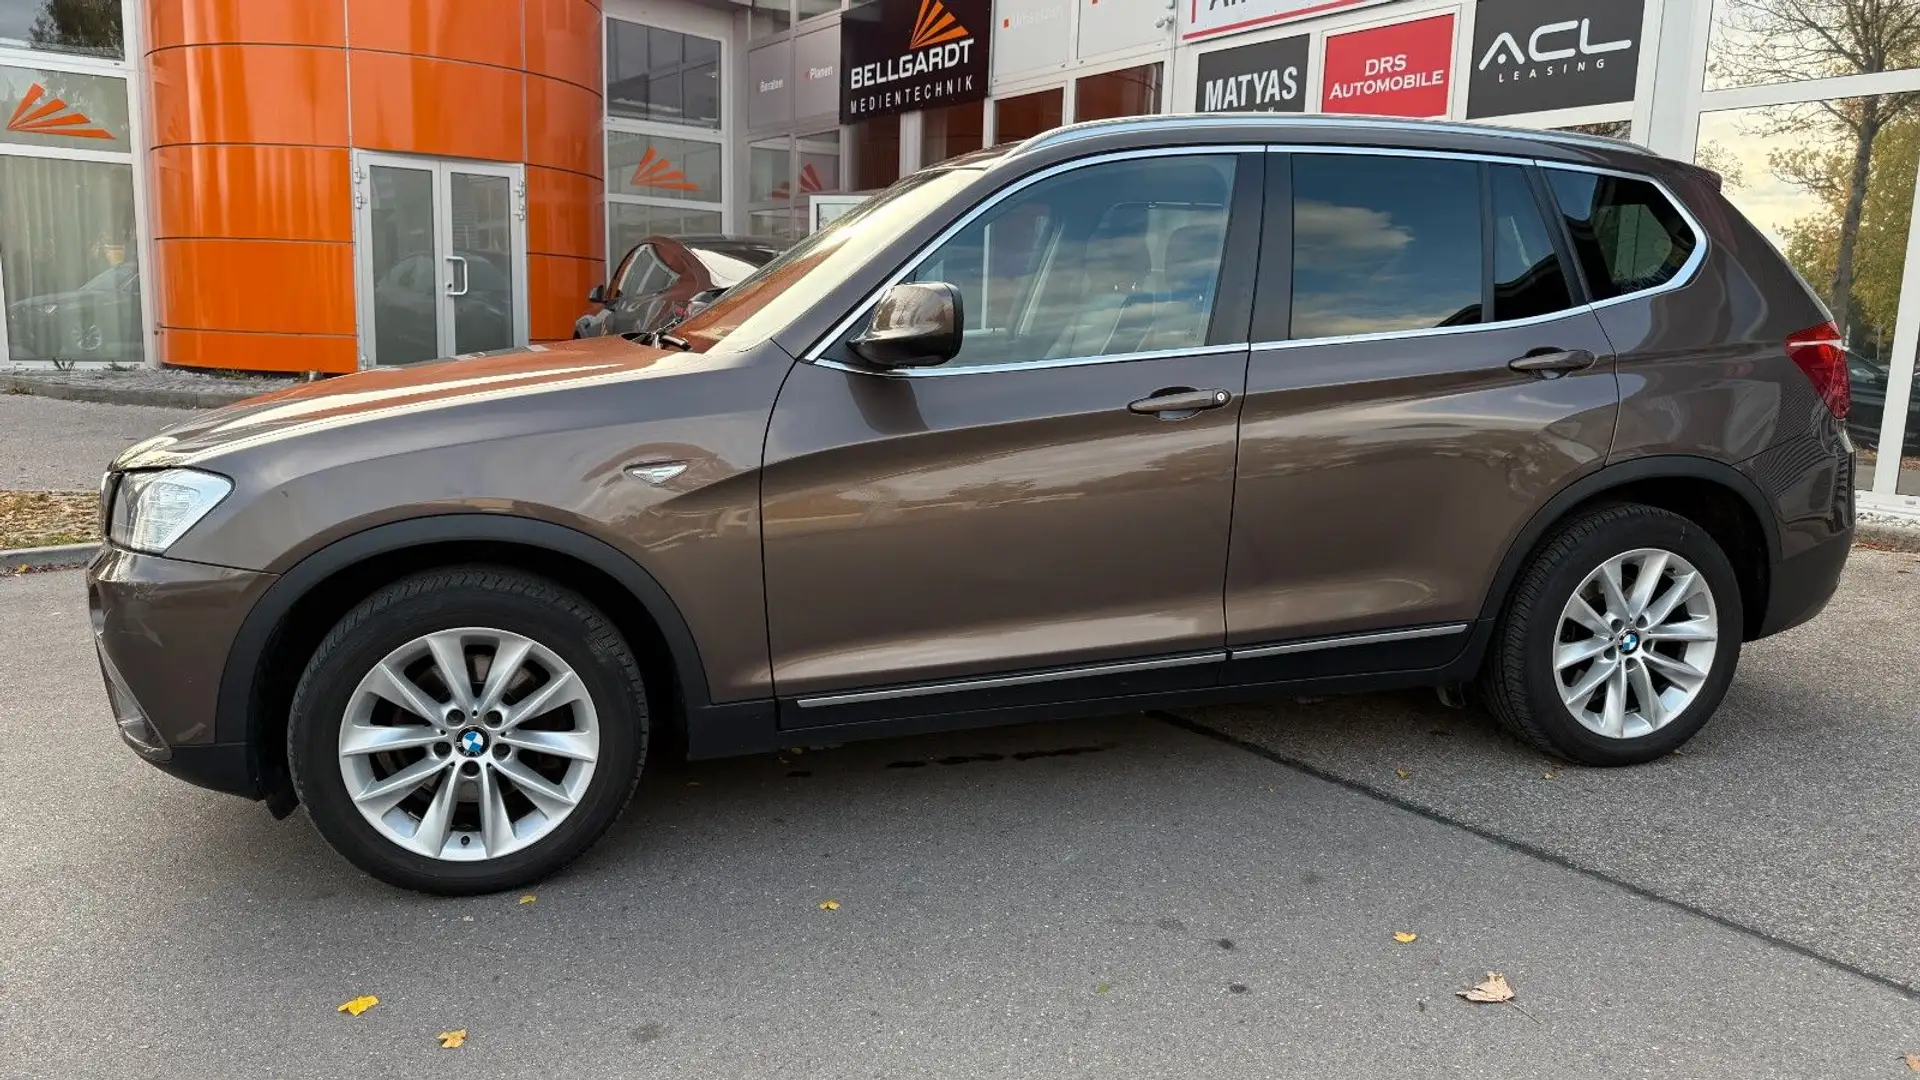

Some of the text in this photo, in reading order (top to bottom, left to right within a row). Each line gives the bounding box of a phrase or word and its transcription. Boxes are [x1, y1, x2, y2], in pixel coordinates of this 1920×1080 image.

[850, 38, 974, 90] BELLGARDT
[1365, 54, 1407, 74] DRS
[1479, 18, 1632, 71] ACL
[1205, 66, 1298, 112] MATYAS
[1329, 69, 1444, 100] AUTOMOBILE
[1498, 59, 1605, 83] LEASING
[850, 75, 973, 114] MEDIENTECHNIK
